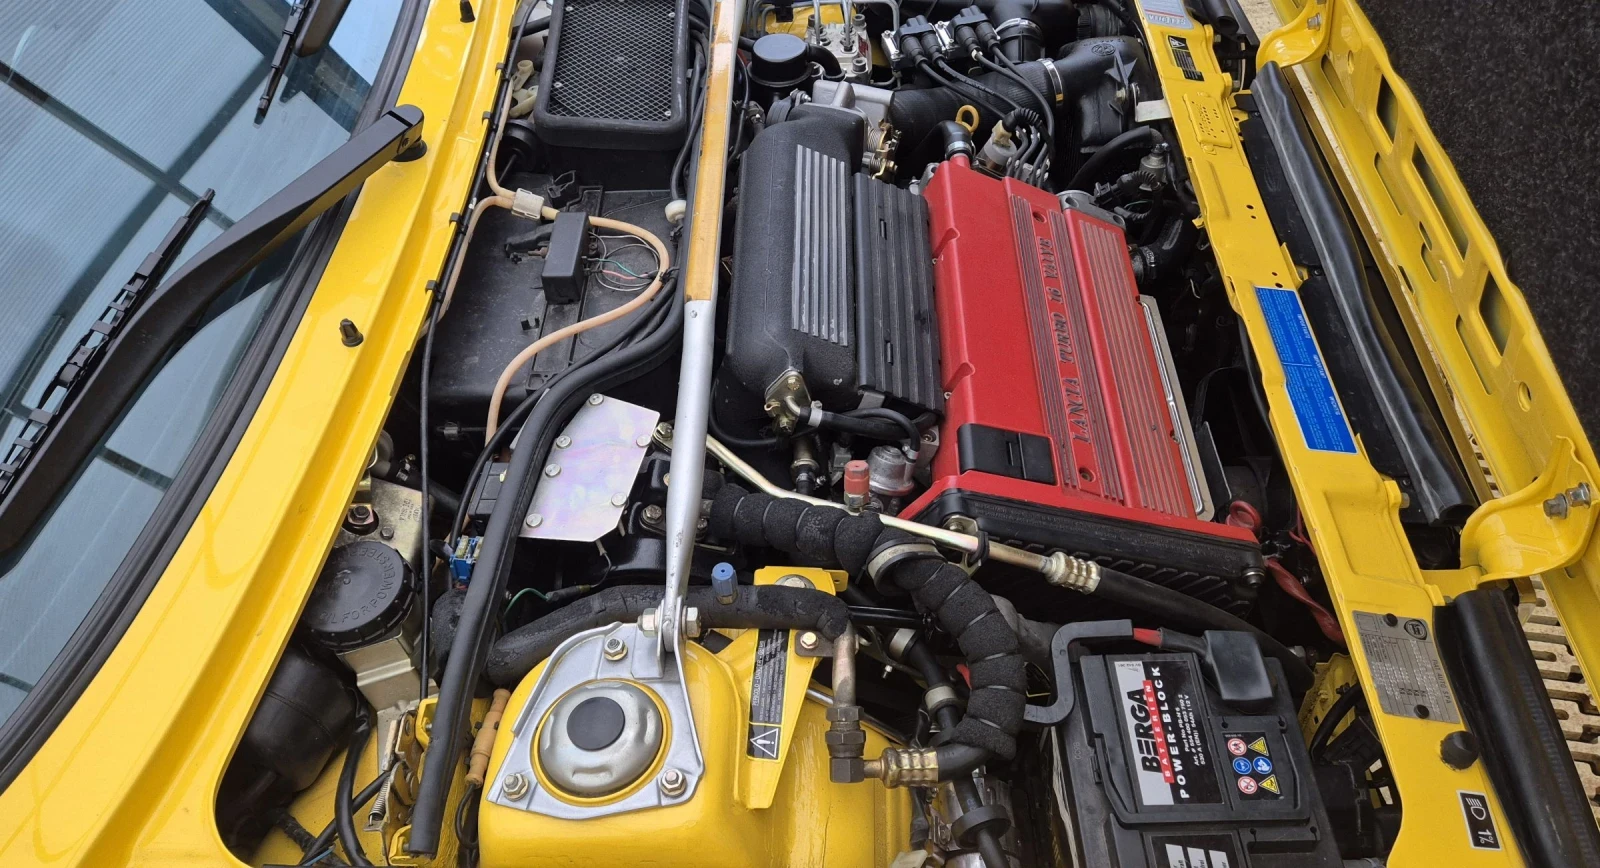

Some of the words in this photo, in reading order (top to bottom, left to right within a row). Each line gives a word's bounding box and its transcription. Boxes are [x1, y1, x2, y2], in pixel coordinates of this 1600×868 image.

[1038, 236, 1059, 279] VALVE
[1046, 286, 1064, 304] 16
[1052, 312, 1075, 364] TURBO
[1062, 377, 1091, 444] LANCIA
[341, 605, 371, 623] FOR
[368, 564, 396, 608] POWER
[1127, 688, 1163, 773] BERGA
[1144, 685, 1171, 777] BATTERIEN
[1151, 666, 1190, 799] POWER-BLOCK
